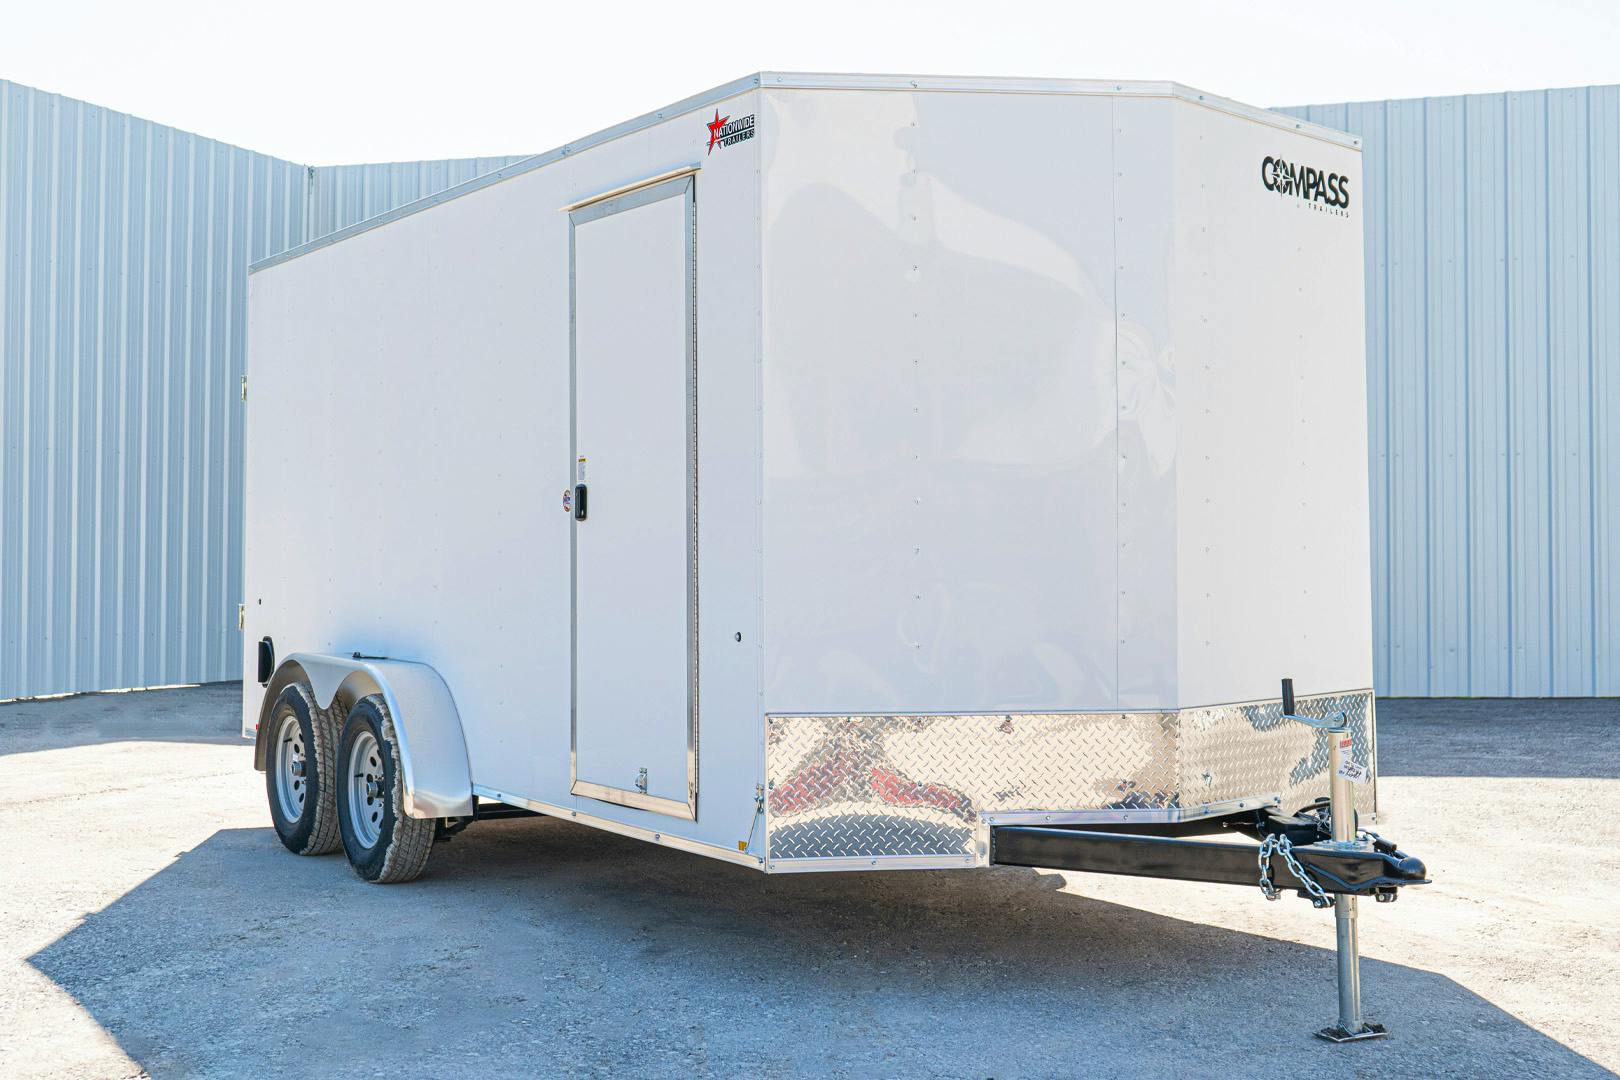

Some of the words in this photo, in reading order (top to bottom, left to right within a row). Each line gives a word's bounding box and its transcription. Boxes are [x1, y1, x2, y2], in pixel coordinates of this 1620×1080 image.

[714, 115, 755, 138] NATIONWIDE
[723, 129, 755, 147] TRAILERS
[1262, 155, 1350, 209] COMPASS
[1308, 203, 1350, 218] TRAILERS
